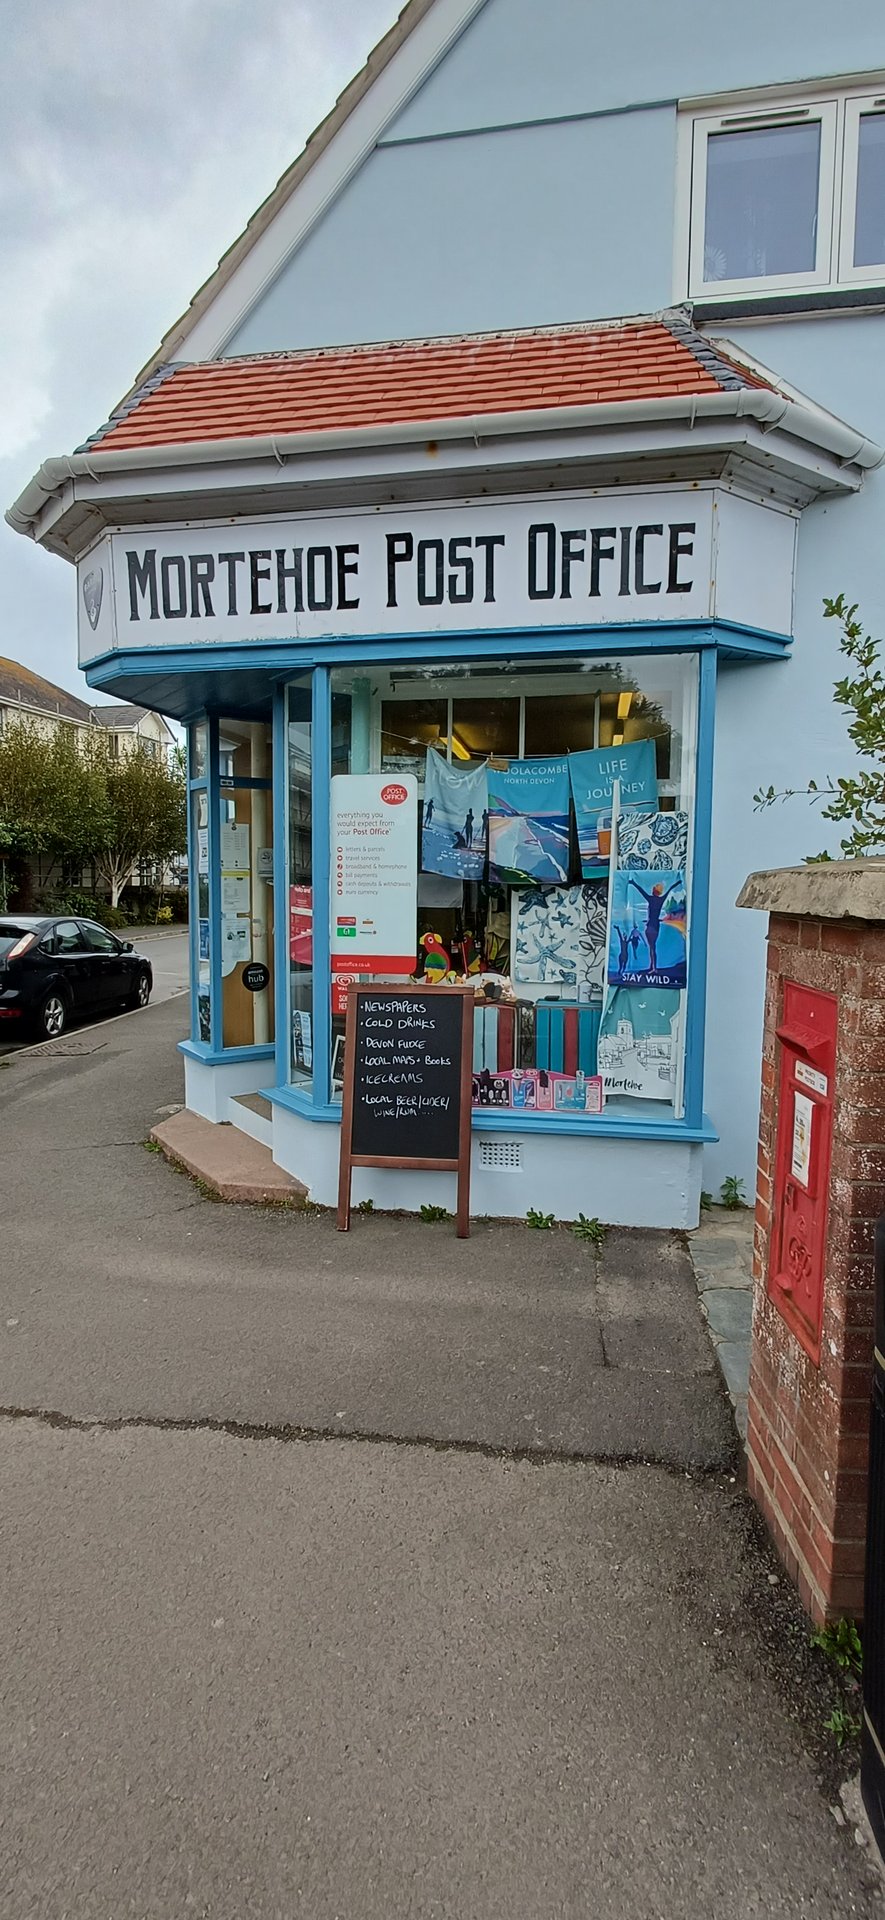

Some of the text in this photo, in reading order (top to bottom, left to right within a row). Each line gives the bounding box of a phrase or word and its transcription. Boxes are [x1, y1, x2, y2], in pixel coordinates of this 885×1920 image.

[125, 523, 696, 621] MORTEHOE POST OFFICE
[598, 758, 628, 775] LIFE
[586, 781, 646, 800] JOUNEY
[336, 812, 370, 820] everything
[336, 820, 396, 829] would expect from
[336, 829, 351, 837] your
[353, 828, 368, 836] Post
[336, 961, 371, 969] postoffice.co.uk
[248, 974, 265, 983] hub
[622, 972, 670, 985] STAY WILD
[364, 1000, 427, 1013] NEWSPAPERS
[365, 1016, 436, 1029] COLD DRINKS
[366, 1036, 427, 1049] DEVON FUDGE
[364, 1055, 391, 1066] LOCAL
[392, 1055, 415, 1065] MAPS
[366, 1093, 393, 1104] LOCAL
